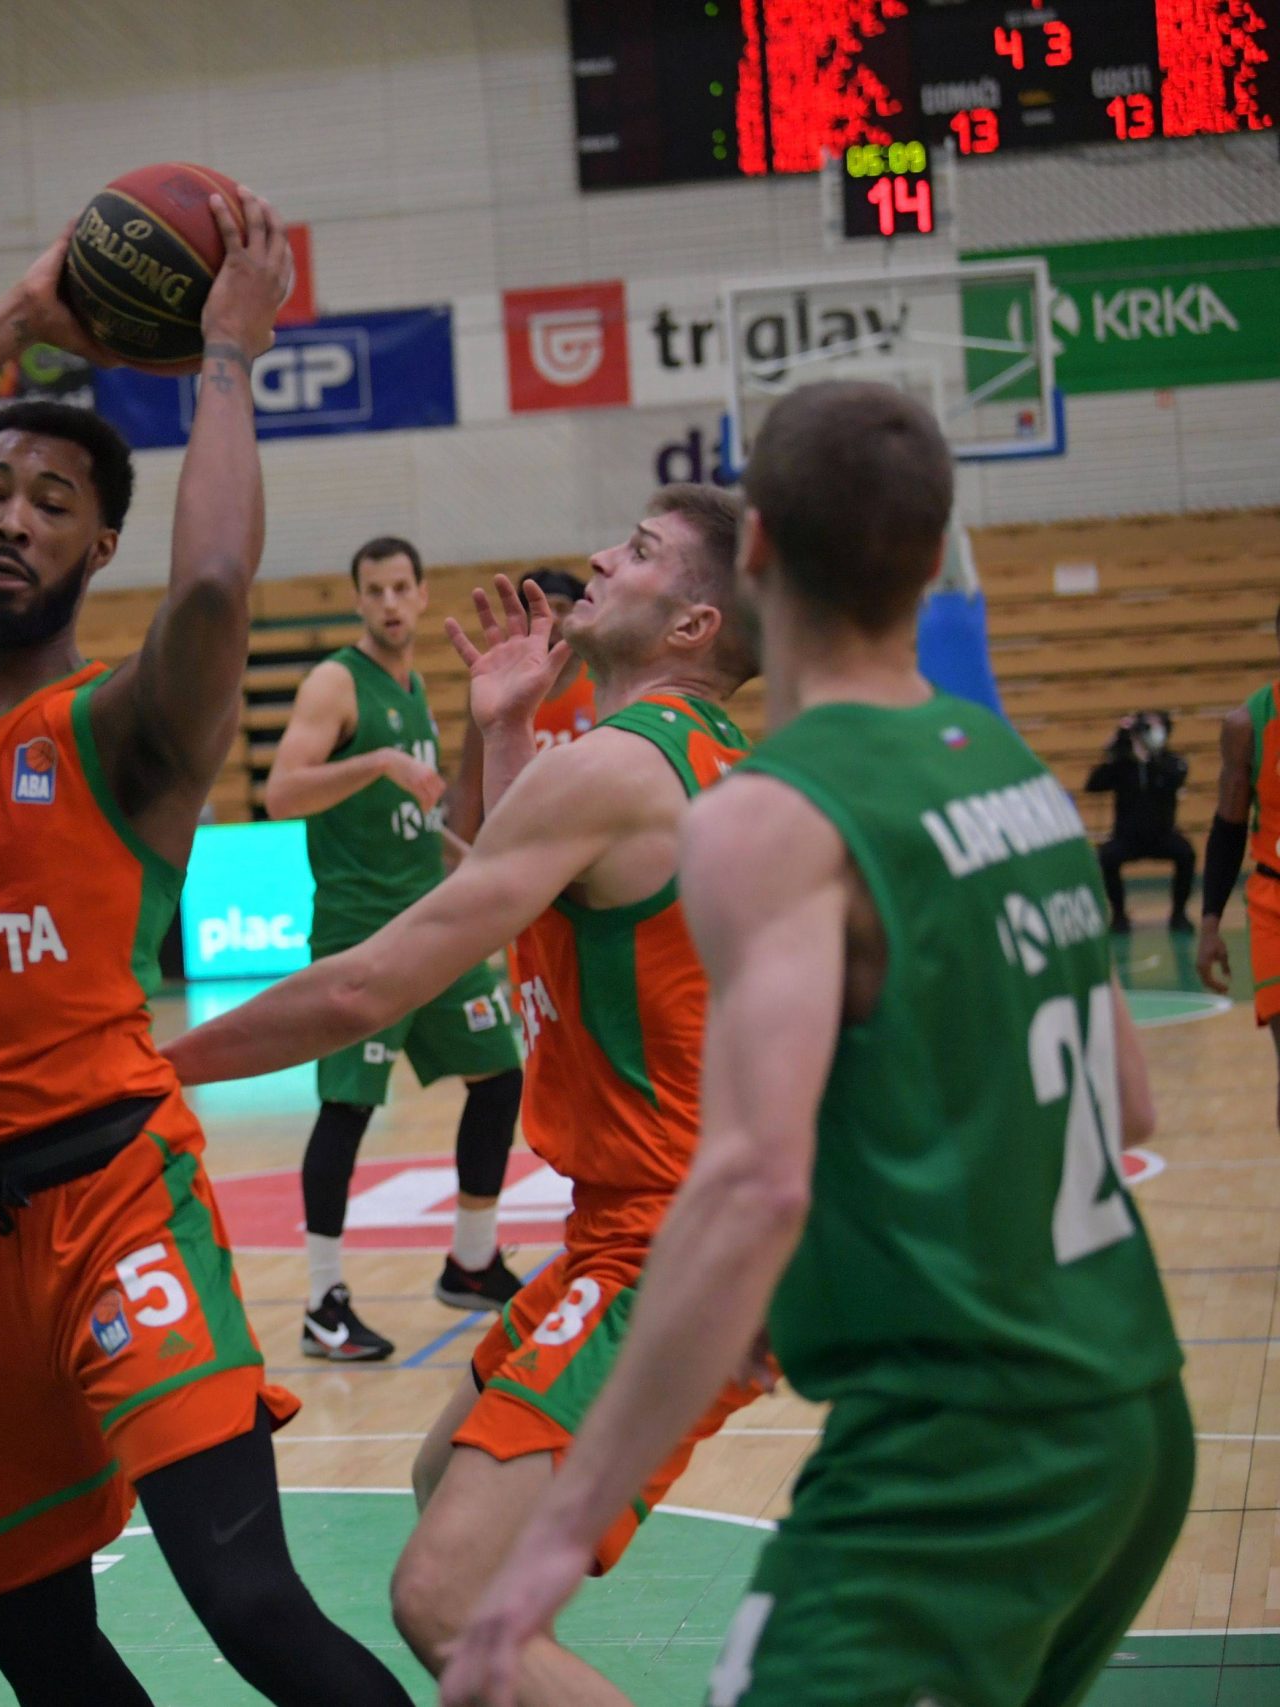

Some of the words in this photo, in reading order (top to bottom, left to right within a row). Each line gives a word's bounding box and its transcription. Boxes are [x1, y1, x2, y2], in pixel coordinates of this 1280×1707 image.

[994, 26, 1024, 70] 4
[1043, 21, 1072, 66] 3
[950, 108, 999, 154] 13
[1107, 94, 1154, 140] 13
[867, 176, 932, 236] 14
[653, 291, 908, 382] trglav
[1092, 282, 1240, 343] KRKA
[195, 343, 354, 413] GP
[17, 773, 51, 799] ABA
[115, 1242, 188, 1327] 5
[533, 1276, 602, 1346] 8
